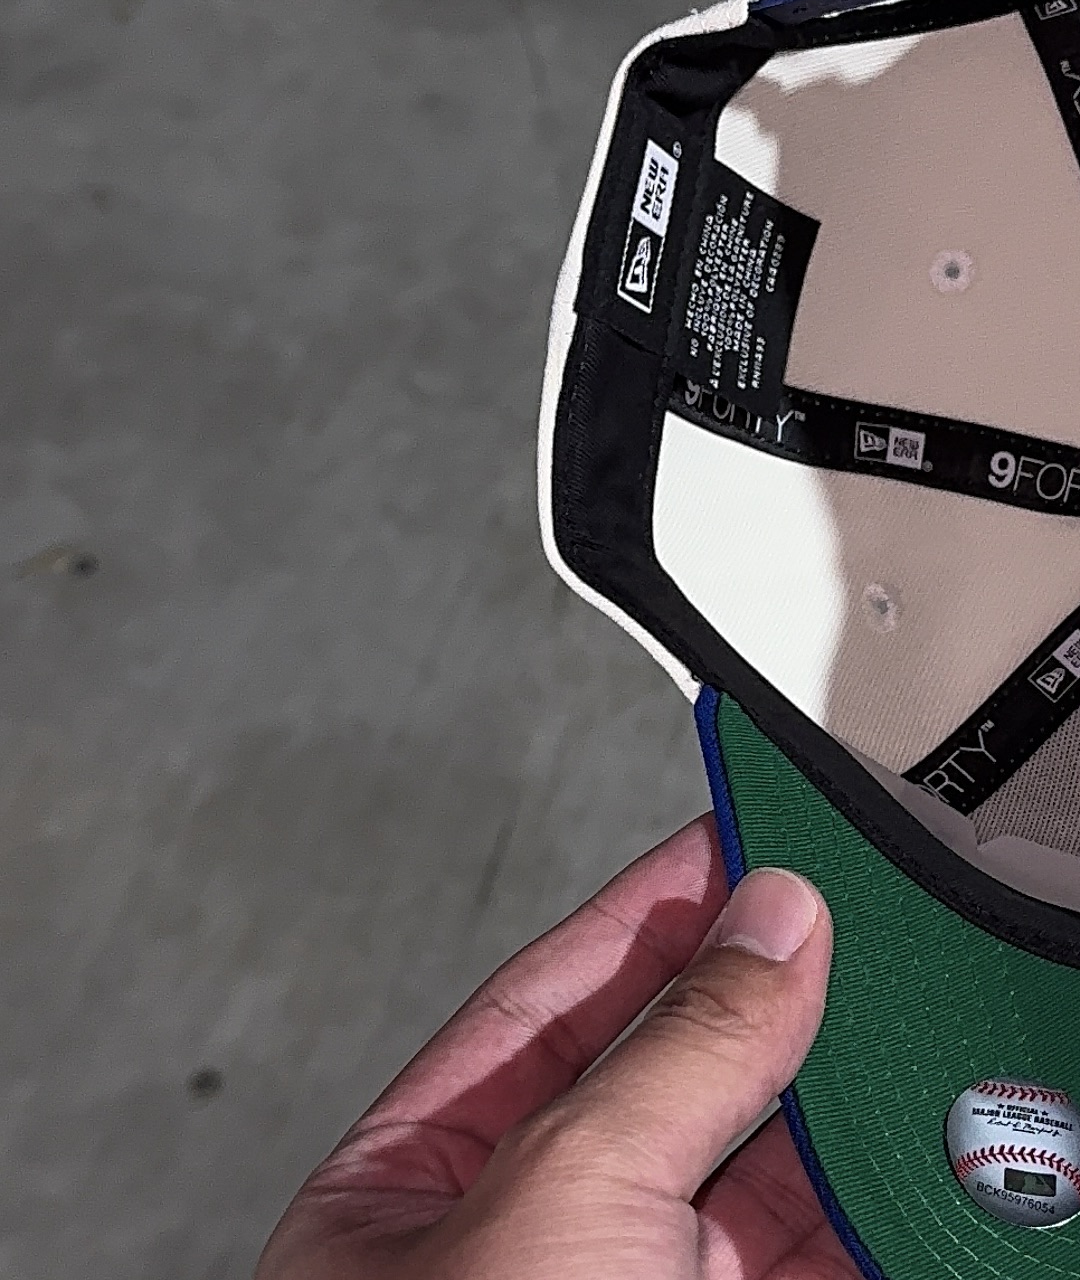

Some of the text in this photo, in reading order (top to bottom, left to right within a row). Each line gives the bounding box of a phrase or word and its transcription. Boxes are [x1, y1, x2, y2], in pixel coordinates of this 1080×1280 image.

[640, 157, 659, 215] NEW
[652, 166, 669, 222] ERA
[893, 436, 919, 451] NEW
